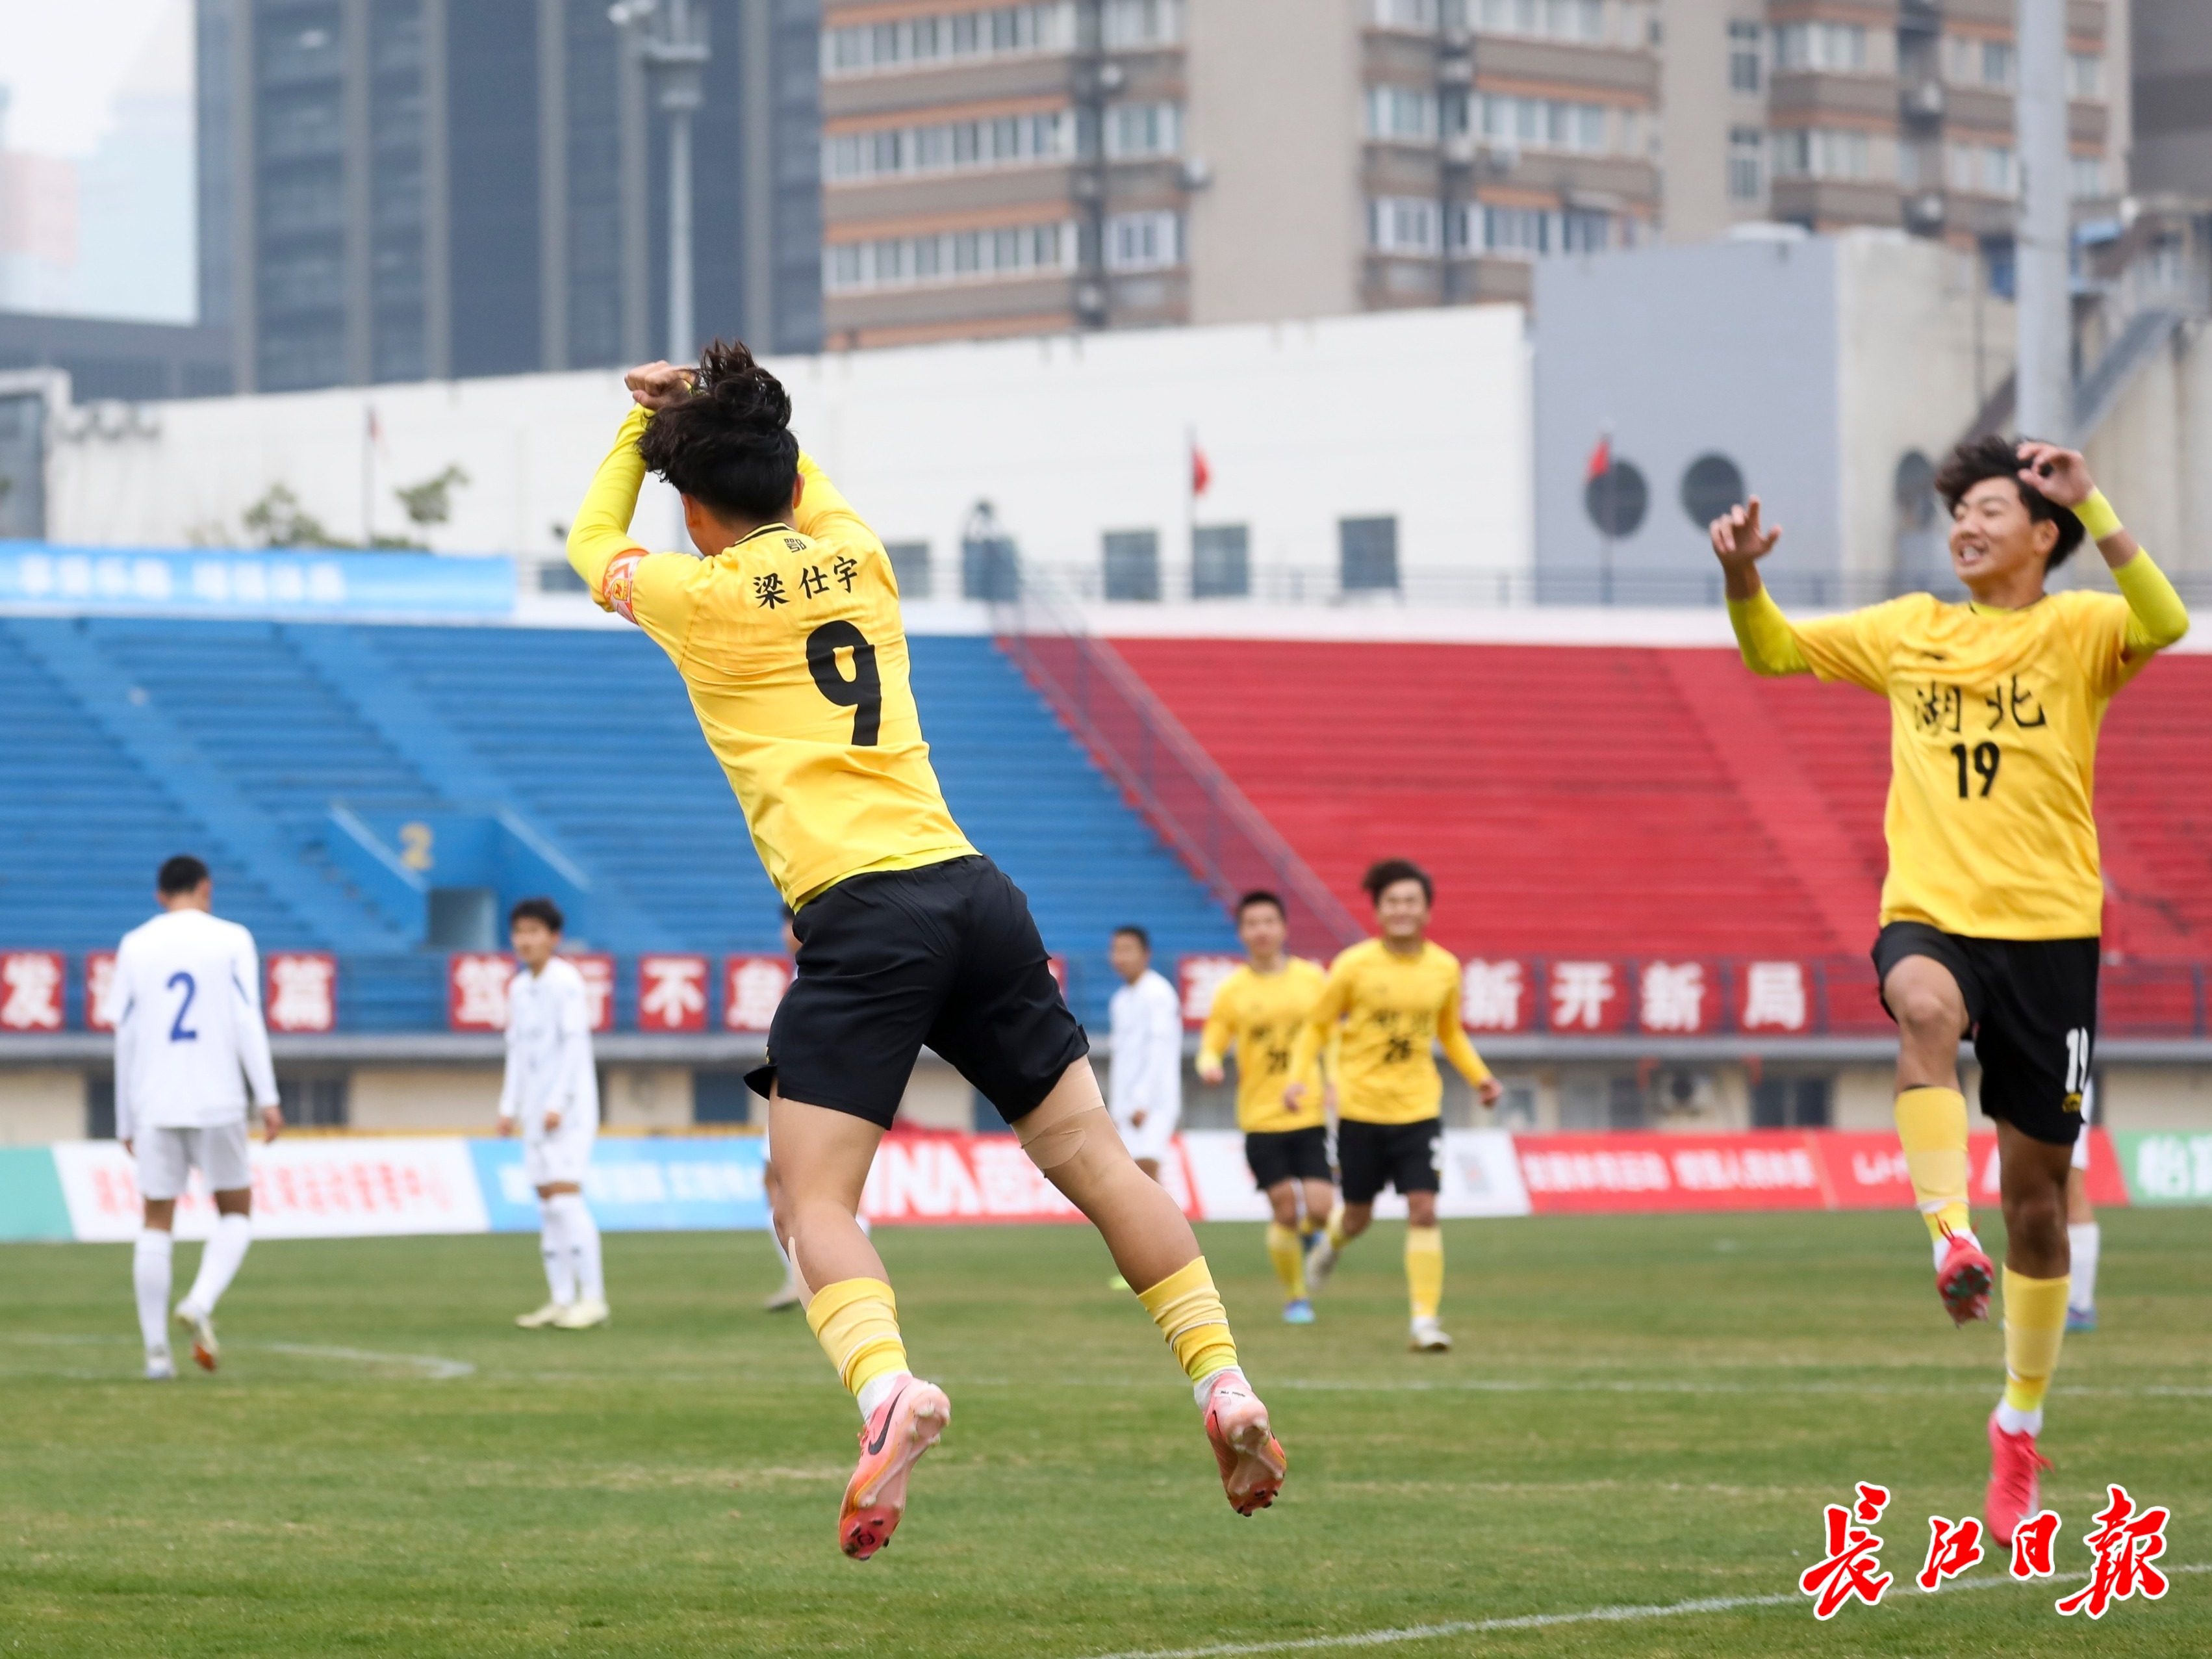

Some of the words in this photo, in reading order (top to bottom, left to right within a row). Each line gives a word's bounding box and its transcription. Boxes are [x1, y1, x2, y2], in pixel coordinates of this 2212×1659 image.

[783, 538, 807, 553] 鄂
[753, 556, 858, 610] 梁仕宇
[806, 621, 882, 747] 9
[1915, 675, 2047, 737] 湖北
[1950, 741, 2000, 799] 19
[166, 971, 198, 1042] 2
